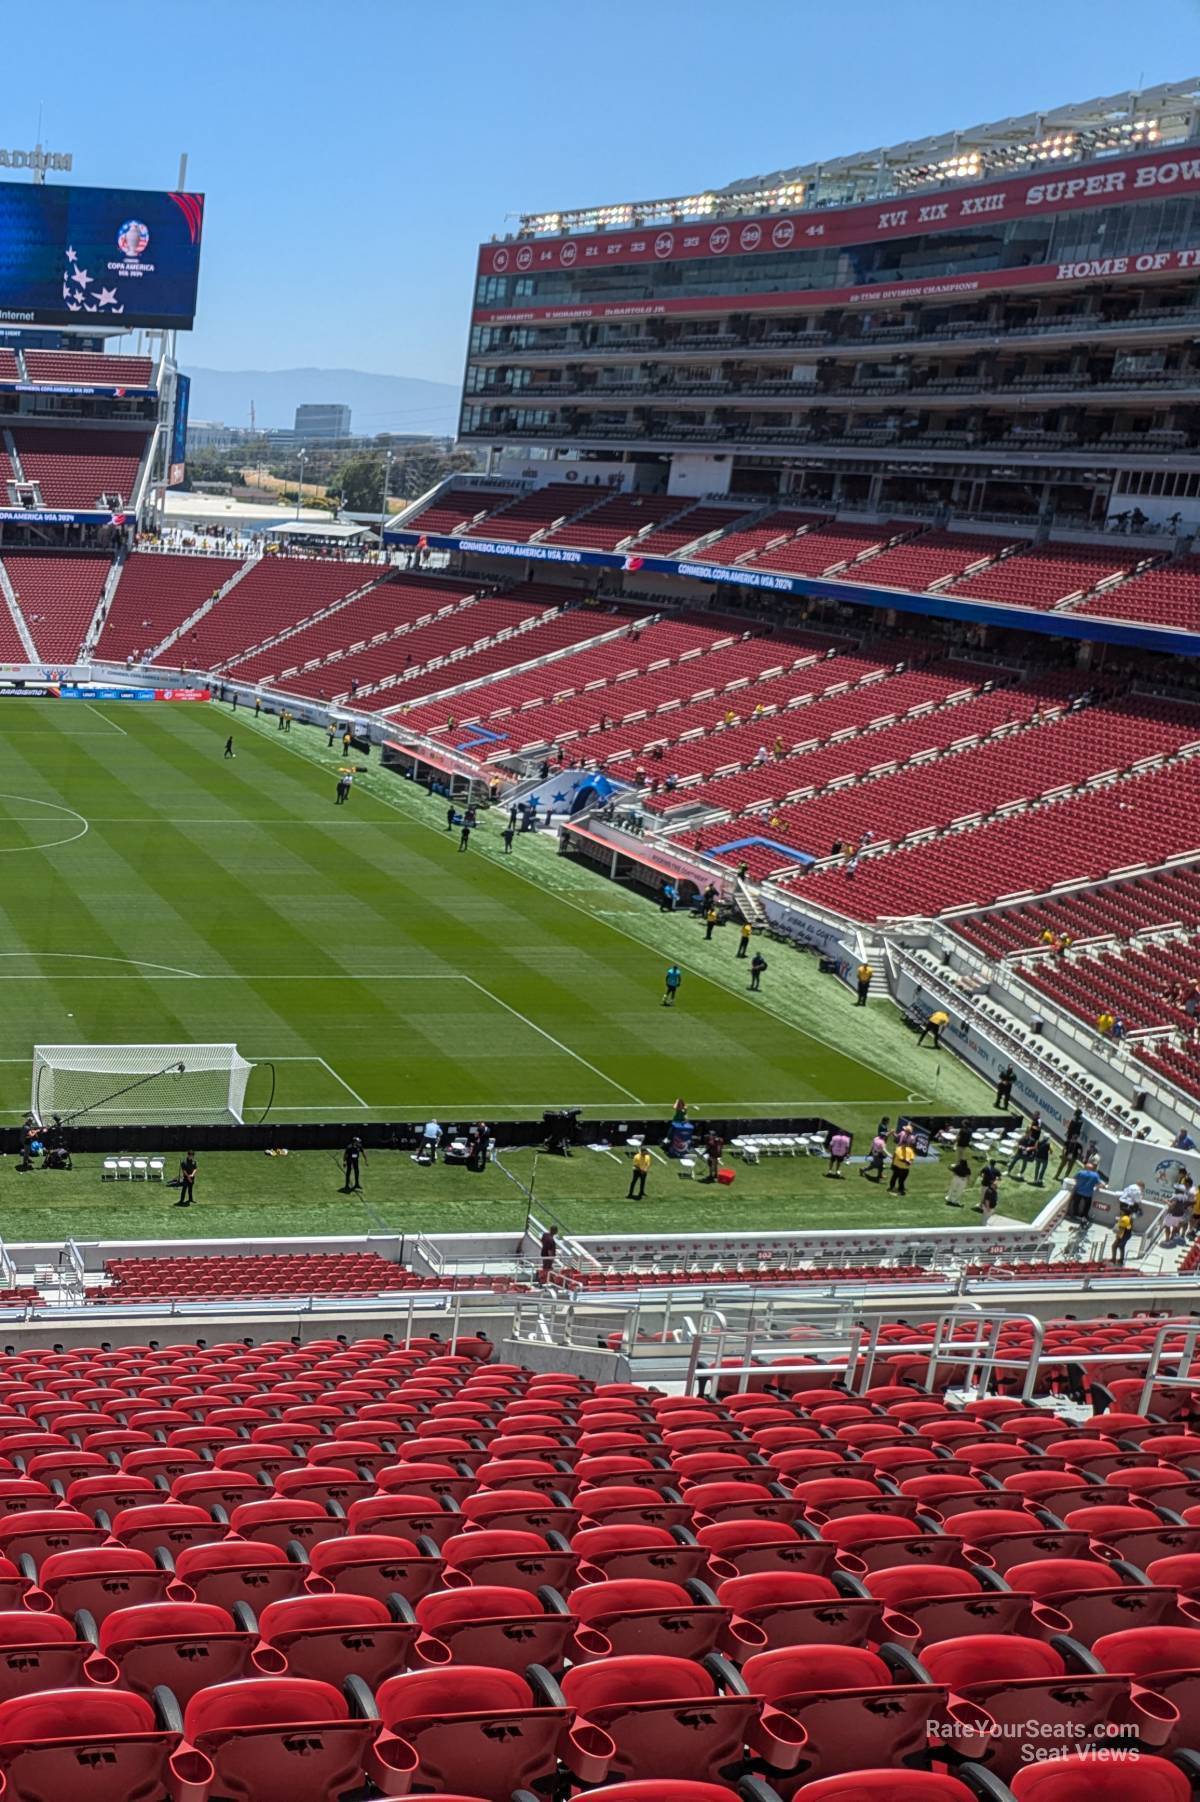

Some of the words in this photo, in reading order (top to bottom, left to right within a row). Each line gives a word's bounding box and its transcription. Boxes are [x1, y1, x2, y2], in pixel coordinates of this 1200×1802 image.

[1025, 172, 1126, 205] SUPER
[1133, 159, 1200, 188] BOW
[877, 210, 909, 229] XVI
[917, 204, 949, 222] XIX
[959, 194, 1006, 215] XXIII
[775, 228, 793, 238] 42
[805, 225, 825, 236] 44
[1056, 258, 1128, 280] HOME
[1136, 253, 1170, 271] OF
[0, 309, 34, 320] Internet
[14, 512, 43, 520] AMERICA
[459, 541, 495, 552] CONMEBOL
[496, 544, 514, 555] COPA
[514, 545, 546, 558] AMERICA
[562, 551, 581, 562] 2024
[678, 563, 712, 577] CONMEBOL
[713, 568, 730, 581] COPA
[730, 571, 760, 586] AMERICA
[775, 577, 793, 590] 2024
